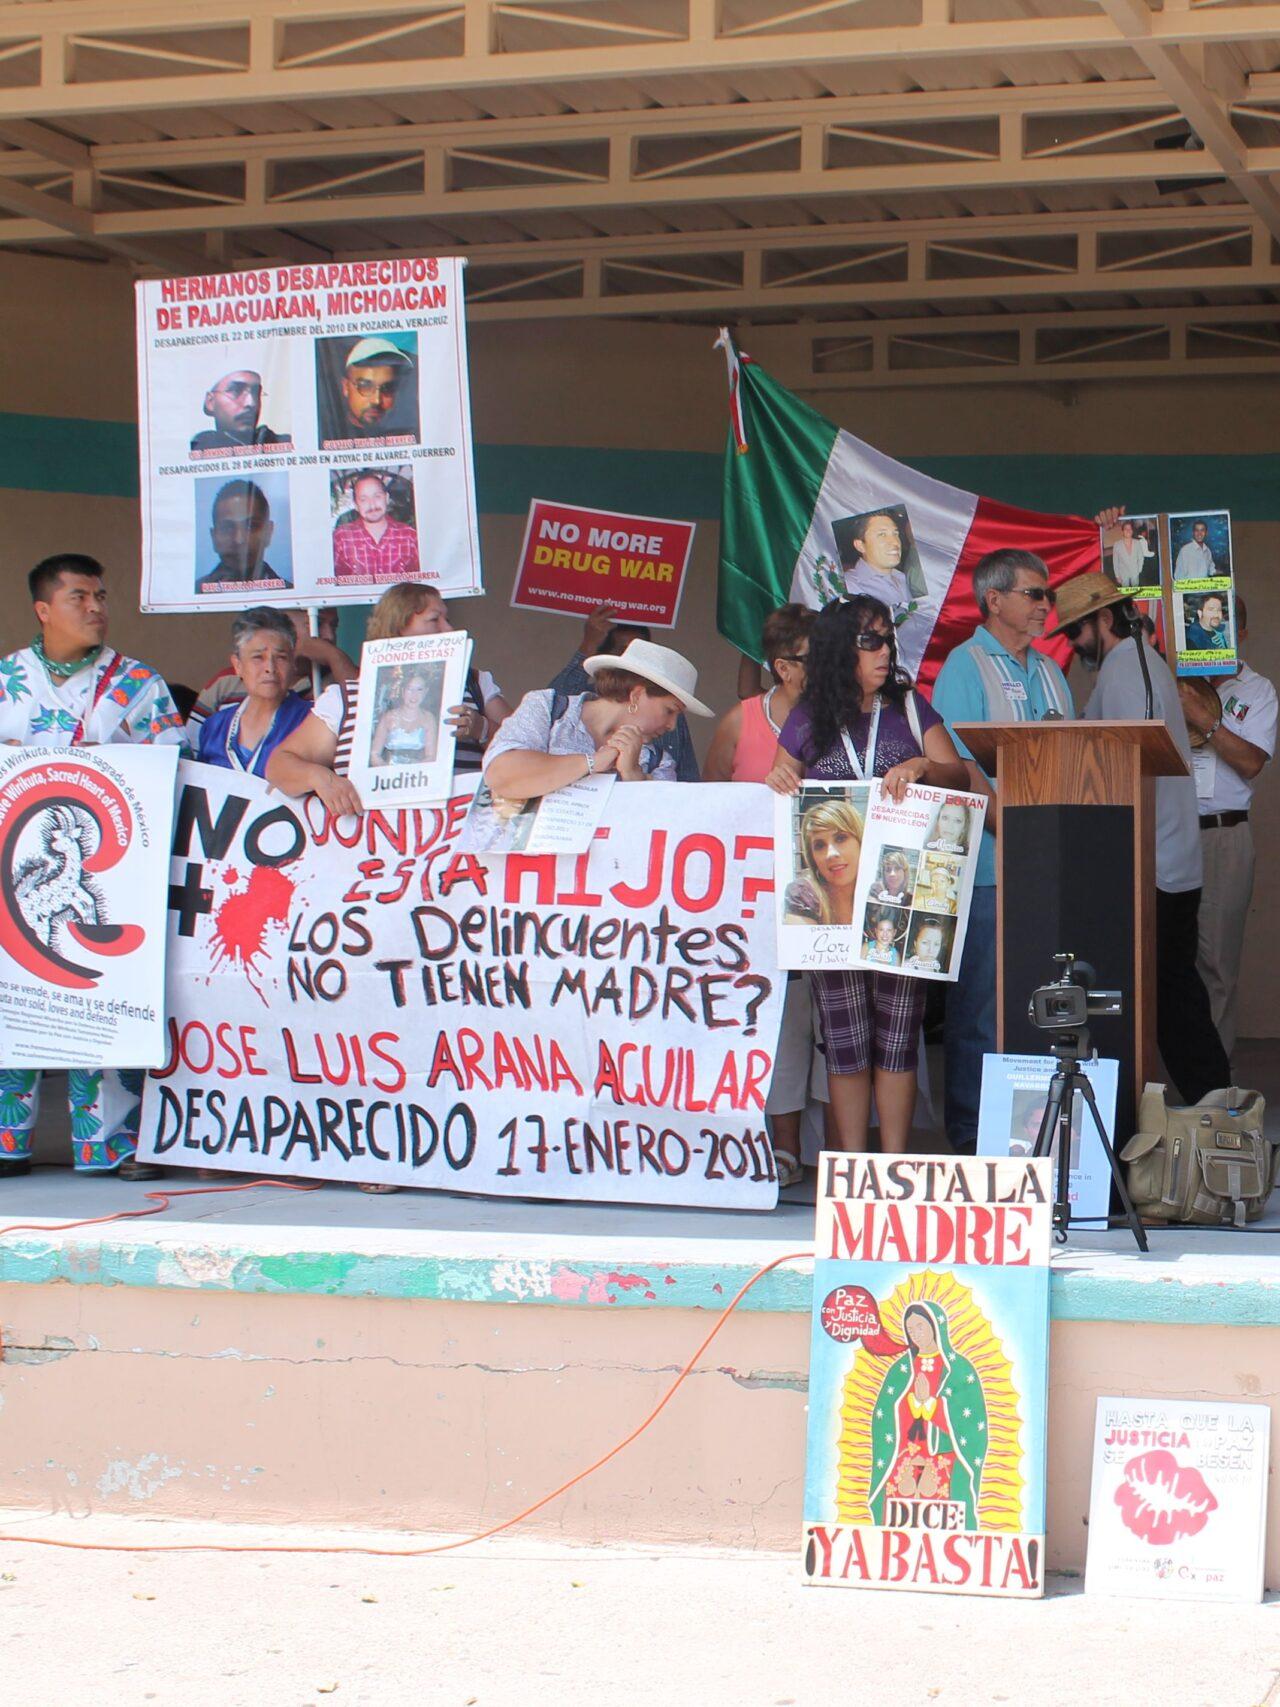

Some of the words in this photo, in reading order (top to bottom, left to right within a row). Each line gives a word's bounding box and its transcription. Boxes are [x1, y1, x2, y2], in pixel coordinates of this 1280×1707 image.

[161, 270, 271, 303] HERMANOS
[277, 257, 439, 292] DESAPARECIDOS
[156, 307, 183, 331] DE
[188, 294, 321, 328] PAJACUARAN,
[327, 285, 447, 316] MICHOACAN
[155, 333, 219, 349] DESAPARECIDOS
[243, 329, 255, 340] DE
[257, 326, 306, 338] SEPTIEMBRE
[310, 324, 324, 335] DEL
[326, 323, 345, 334] 2010
[347, 322, 358, 332] EN
[360, 319, 404, 332] POZARICA,
[406, 315, 448, 328] VERACRUZ
[159, 463, 220, 475] DESAPARECIDOS
[254, 456, 285, 468] AGOSTO
[319, 453, 330, 464] EN
[333, 451, 361, 463] ATOYAC
[412, 447, 455, 459] GUERRERO
[539, 519, 580, 543] NO
[587, 527, 663, 556] MORE
[533, 545, 612, 575] DRUG
[620, 558, 675, 582] WAR
[46, 767, 81, 785] Sacred
[80, 773, 106, 799] Heart
[92, 755, 126, 787] sagrado
[124, 787, 136, 801] de
[371, 770, 429, 792] Judith
[101, 795, 116, 808] of
[904, 787, 941, 803] ONDE
[108, 803, 129, 847] Mexico
[171, 784, 307, 868] NO
[303, 790, 476, 857] DONDE
[342, 845, 490, 905] ESTA
[288, 906, 374, 956] LOS
[411, 904, 750, 972] Delincuentes
[21, 984, 50, 999] vende,
[64, 993, 83, 1006] ama
[107, 999, 156, 1022] defiende
[287, 957, 347, 1002] NO
[374, 958, 532, 1010] TIENEN
[550, 965, 773, 1037] MADRE?
[148, 1017, 268, 1080] JOSE
[281, 1027, 407, 1094] LUIS
[426, 1027, 584, 1097] ARANA
[594, 1039, 772, 1113] AGUILAR
[153, 1085, 477, 1171] DESAPARECIDO
[497, 1114, 777, 1182] 17-ENERO-2011
[825, 1157, 976, 1203] HASTA
[985, 1162, 1047, 1203] LA
[829, 1201, 1033, 1266] MADRE
[831, 1306, 878, 1325] Justicia
[835, 1288, 869, 1307] Paz
[831, 1323, 881, 1342] Dignidad
[1104, 1410, 1169, 1429] HASTA
[1181, 1413, 1219, 1431] QUE
[1227, 1415, 1255, 1433] LA
[1104, 1430, 1191, 1449] JUSTICIA
[888, 1500, 965, 1531] DICE:
[805, 1526, 872, 1581] ¡YA
[880, 1530, 1039, 1590] BASTA!
